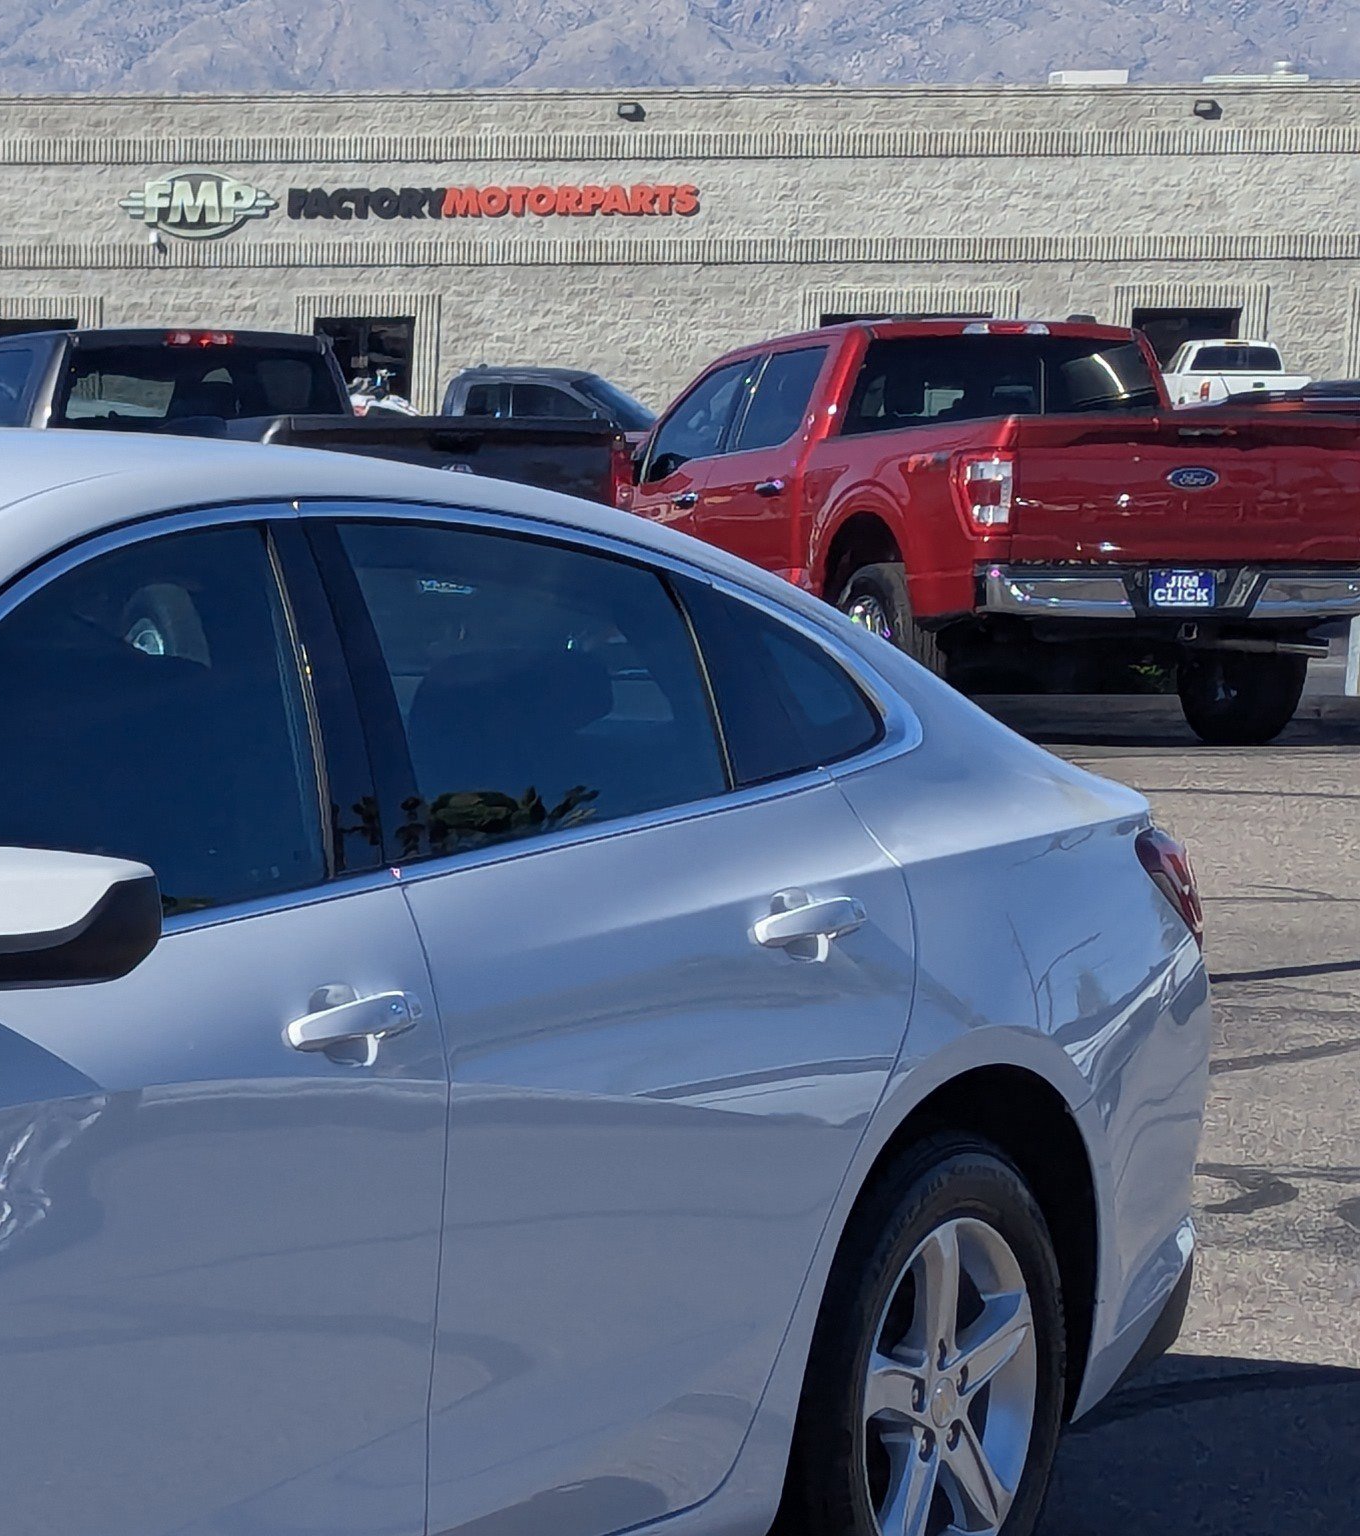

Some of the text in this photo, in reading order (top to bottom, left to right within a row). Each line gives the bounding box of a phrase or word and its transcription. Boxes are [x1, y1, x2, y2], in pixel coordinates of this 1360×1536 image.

[144, 180, 257, 224] FMP
[1165, 575, 1200, 589] JIM
[1153, 587, 1209, 602] CLICK
